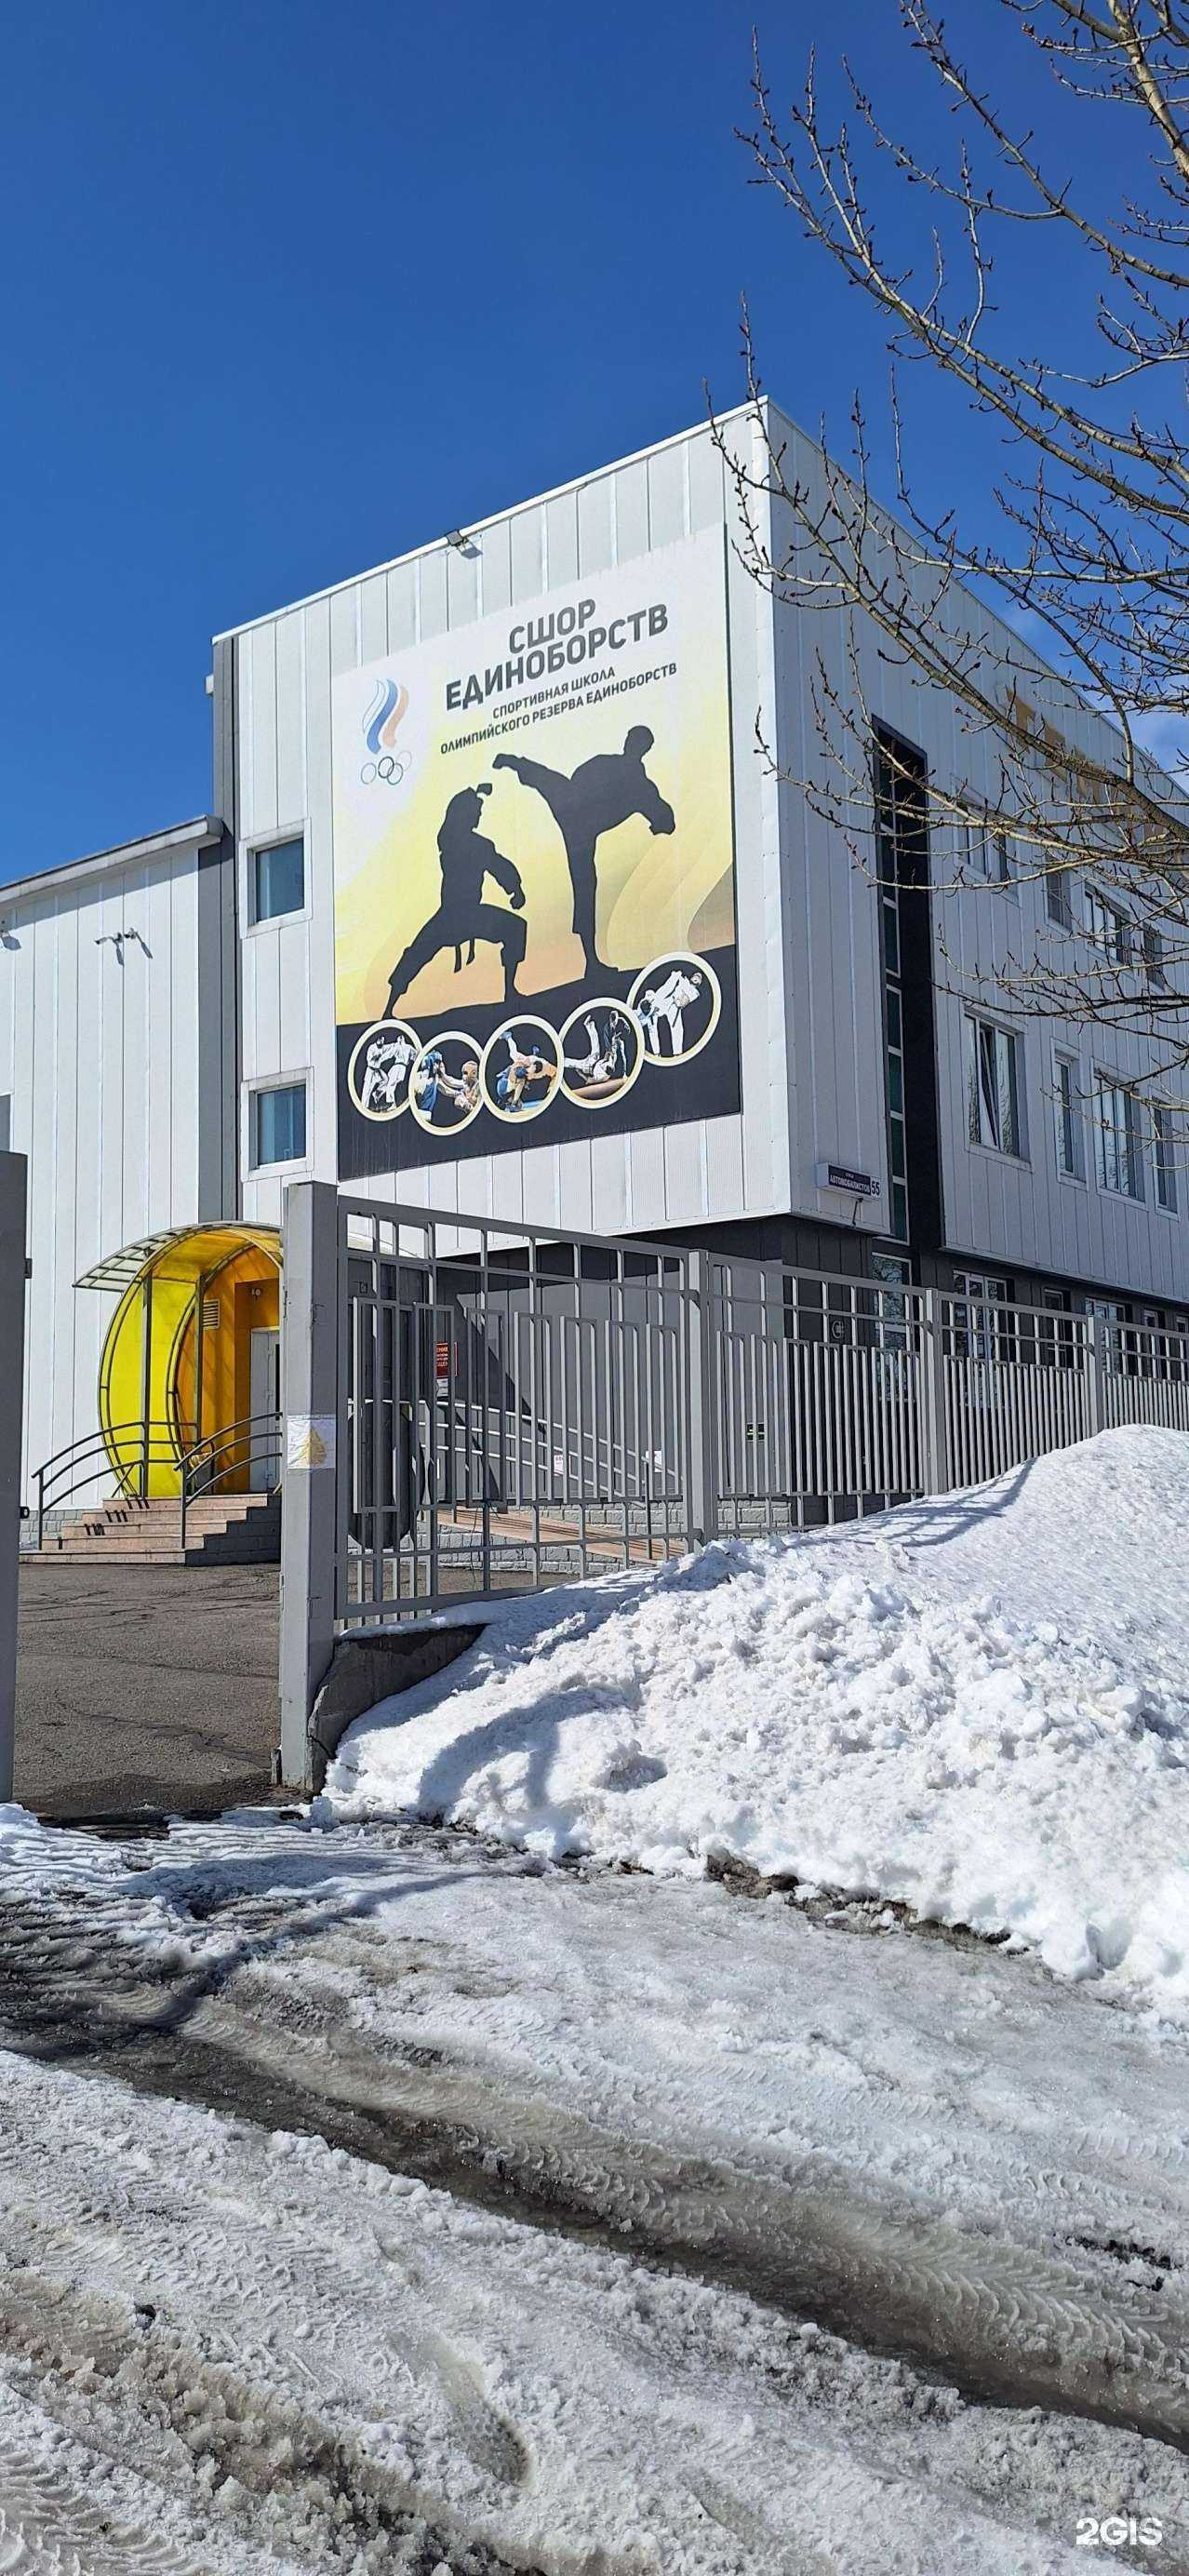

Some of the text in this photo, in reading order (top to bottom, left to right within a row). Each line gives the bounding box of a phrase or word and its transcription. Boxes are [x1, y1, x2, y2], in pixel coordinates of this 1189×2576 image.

[446, 604, 669, 711] ЕДИНОБОРСТВ
[509, 598, 596, 654] СШОР
[440, 663, 677, 755] ОЛИМПИЙСКОГО РЕЗЕРВА ЕДИНОБОРСТВ
[492, 666, 616, 719] СПОРТИВНАЯ ШКОЛА
